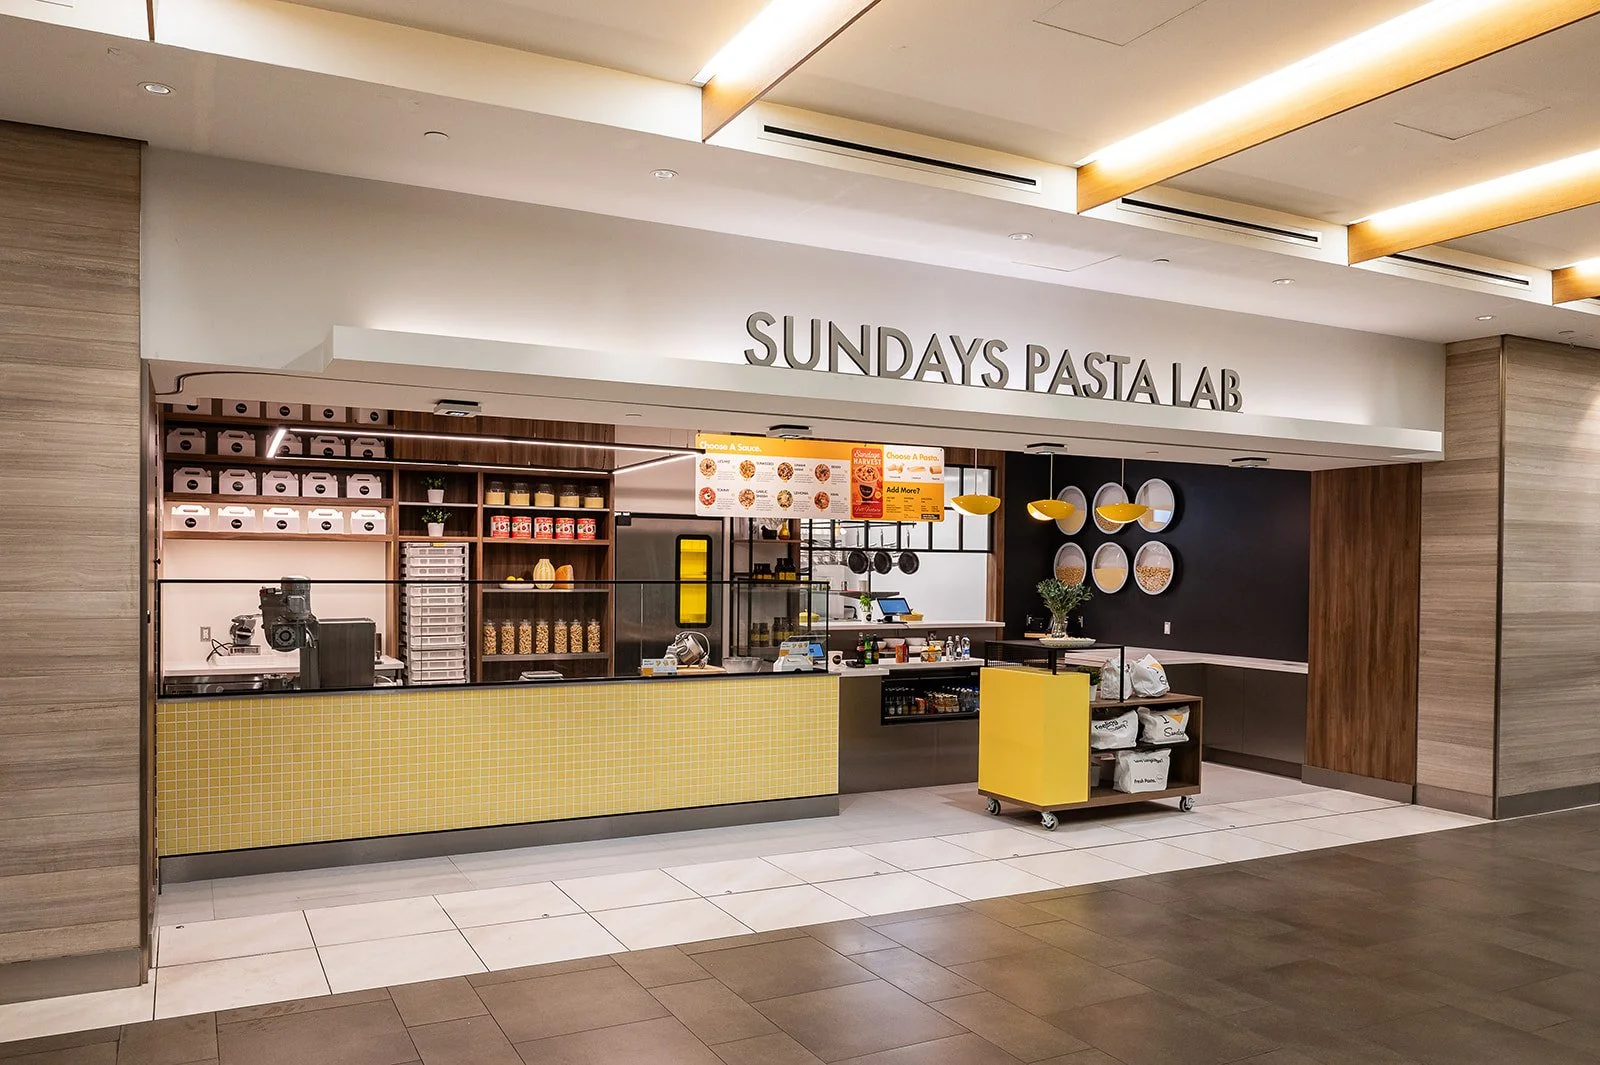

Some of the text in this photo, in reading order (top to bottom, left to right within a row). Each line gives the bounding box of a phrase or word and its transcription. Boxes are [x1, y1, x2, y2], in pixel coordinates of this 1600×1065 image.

[744, 310, 1244, 413] SUNDAYS PASTA LAB
[700, 442, 728, 451] Choose
[738, 444, 762, 453] Sauce.
[886, 452, 911, 460] Choose
[920, 454, 940, 462] Pasta.
[886, 486, 921, 495] Add More?
